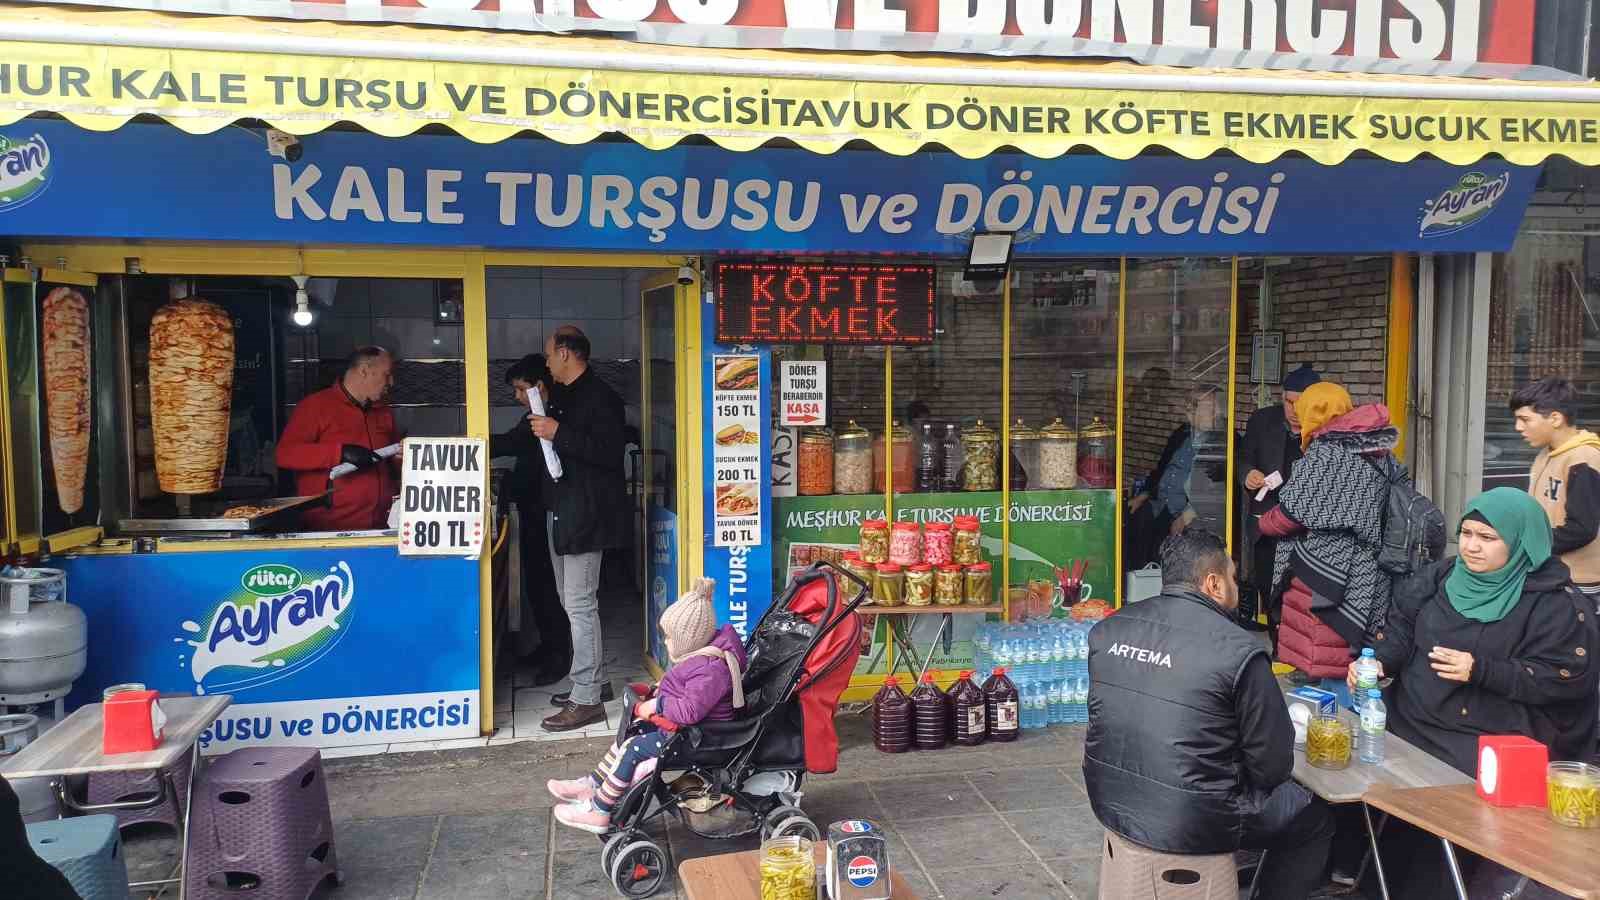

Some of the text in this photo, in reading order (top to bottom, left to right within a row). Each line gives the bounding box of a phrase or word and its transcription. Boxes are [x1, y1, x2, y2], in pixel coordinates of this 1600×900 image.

[112, 68, 247, 103] KALE
[264, 75, 426, 114] TURŞU
[445, 82, 506, 115] VE
[926, 96, 1069, 134] DÖNER
[1085, 101, 1210, 137] KÖFTE
[1223, 111, 1357, 140] EKMEK
[1369, 114, 1490, 142] SUCUK
[1500, 118, 1598, 144] EKME
[272, 163, 1286, 243] KALE TURŞUSU ve DÖNERCİSİ
[1432, 182, 1502, 216] Ayran
[752, 266, 897, 304] KÖFTE
[751, 306, 898, 335] EKMEK
[789, 364, 817, 376] DÖNER
[790, 378, 817, 390] TURŞU
[717, 405, 756, 416] 150 TL
[787, 403, 819, 414] KASA
[409, 444, 480, 471] TAVUK
[717, 469, 757, 480] 200 TL
[405, 480, 480, 512] DÖNER
[786, 510, 862, 531] MEŞHUR
[415, 521, 470, 547] 80 TL
[722, 530, 753, 541] 80 TL
[247, 569, 297, 589] sütaş
[209, 578, 341, 652] Ayran
[1107, 642, 1172, 669] ARTEMA
[280, 717, 314, 737] ve
[322, 697, 471, 735] DÖNERCİSİ
[849, 867, 876, 875] PEPSI
